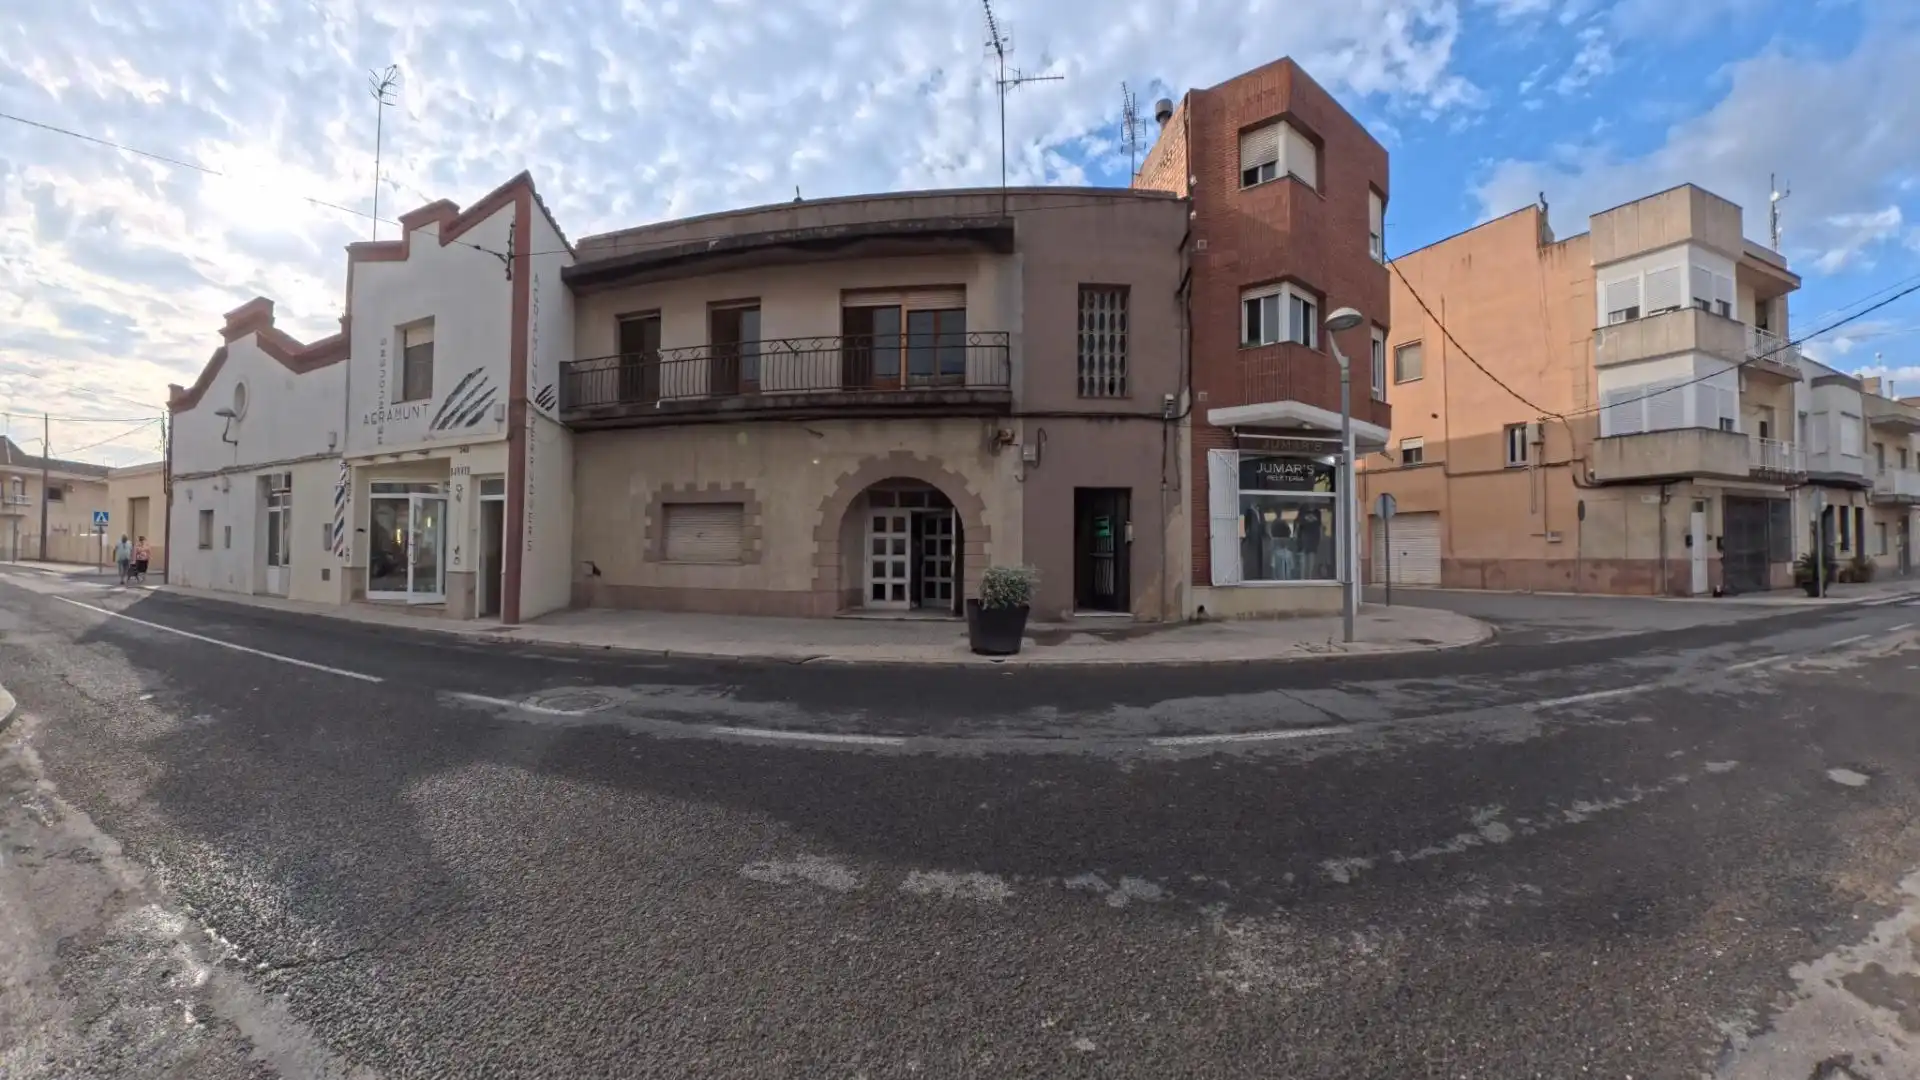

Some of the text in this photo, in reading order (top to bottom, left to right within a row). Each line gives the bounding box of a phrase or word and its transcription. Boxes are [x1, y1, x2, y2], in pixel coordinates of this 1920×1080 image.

[363, 404, 430, 425] AGRAMUNT
[1262, 439, 1323, 452] JUMAR'S
[1256, 463, 1316, 476] JUMAR'S
